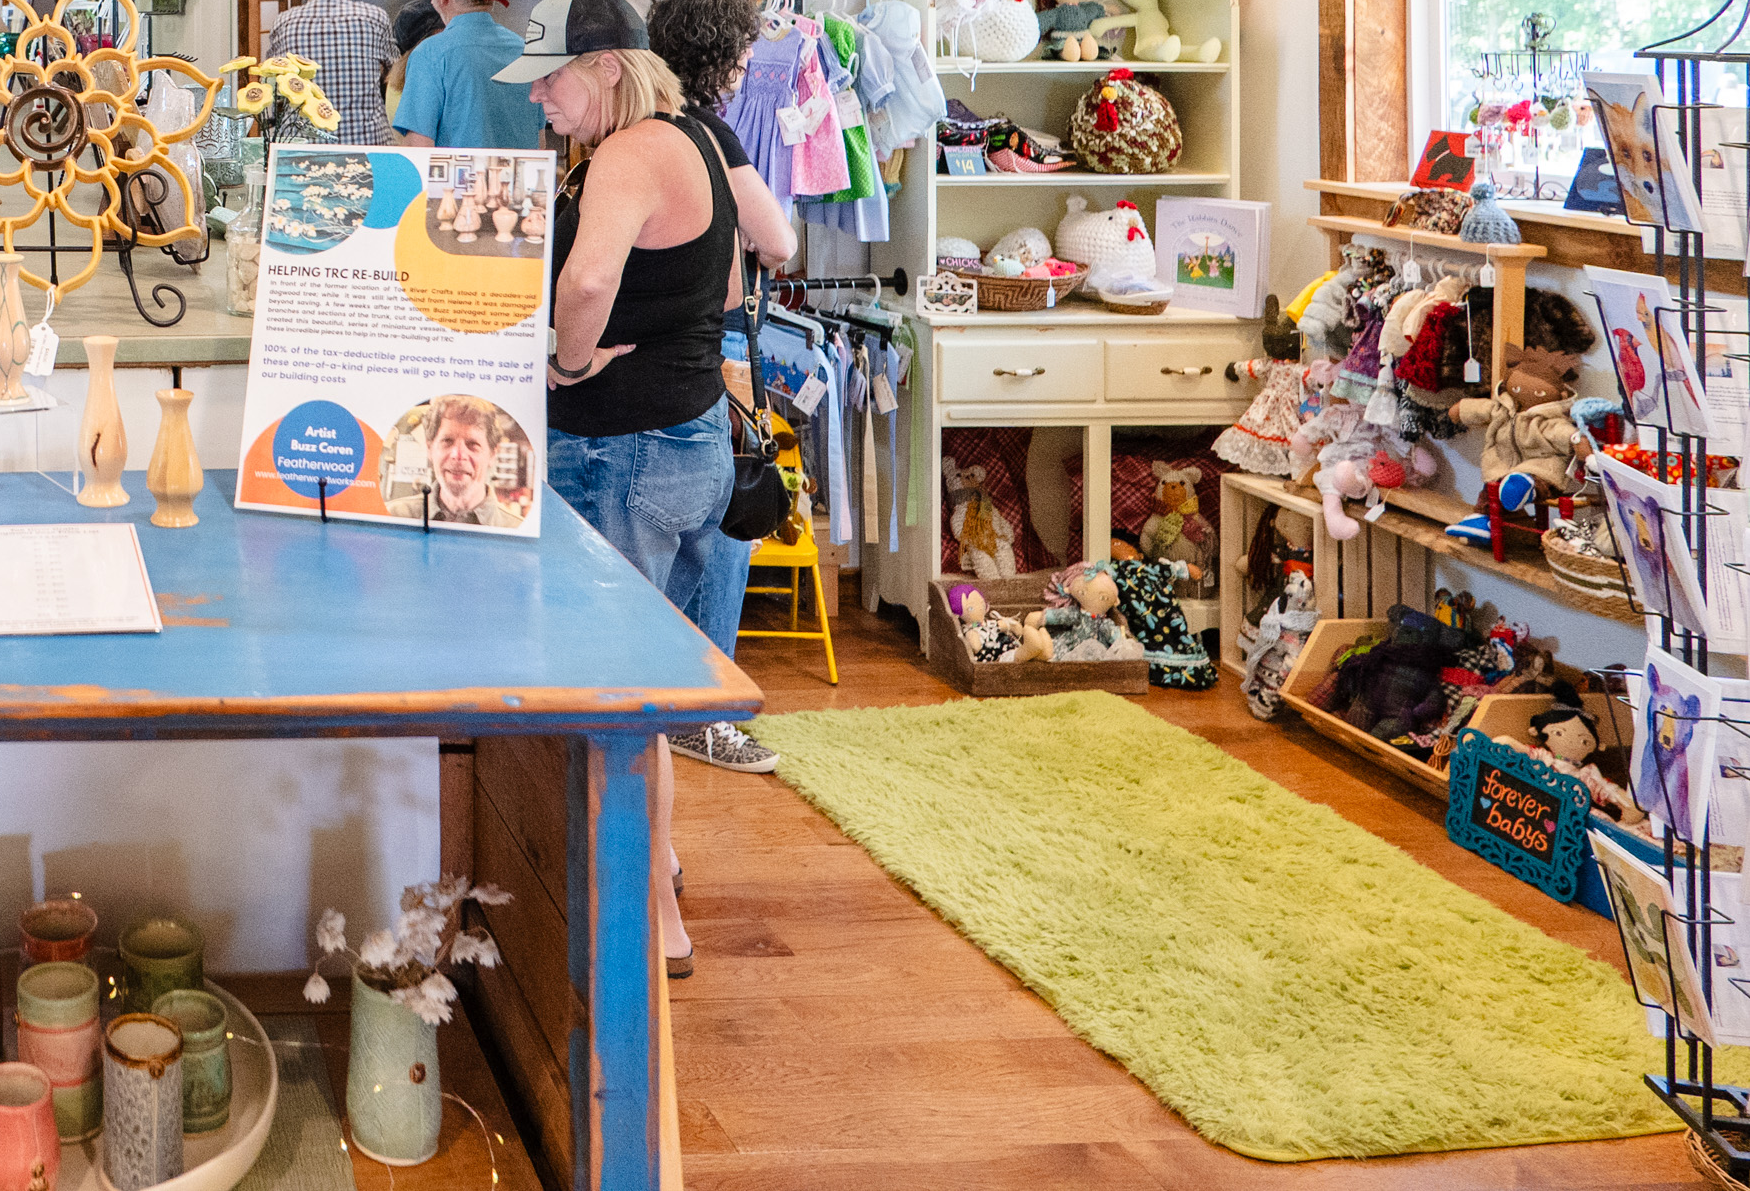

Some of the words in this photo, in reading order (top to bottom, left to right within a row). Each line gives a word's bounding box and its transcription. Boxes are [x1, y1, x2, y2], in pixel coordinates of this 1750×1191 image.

[946, 257, 981, 269] CHICKS
[268, 264, 321, 277] HELPING
[325, 267, 349, 278] TRC
[352, 269, 410, 281] RE-BUILD
[269, 289, 301, 297] dogwood
[500, 301, 536, 310] damaged
[453, 308, 486, 316] salvaged
[381, 322, 416, 330] miniature
[320, 328, 343, 336] pieces
[390, 332, 430, 342] re-building
[264, 344, 288, 353] 100%
[303, 346, 320, 355] the
[322, 348, 396, 360] tax-deductible
[399, 353, 446, 365] proceeds
[449, 356, 474, 365] from
[477, 358, 494, 366] the
[498, 360, 520, 368] sale
[523, 361, 534, 369] of
[263, 357, 289, 366] these
[292, 359, 363, 371] one-of-a-kind
[366, 364, 399, 375] pieces
[402, 366, 420, 374] will
[423, 369, 436, 378] go
[439, 369, 450, 377] to
[453, 370, 476, 380] help
[495, 374, 515, 383] pay
[518, 374, 533, 382] off
[279, 371, 319, 383] building
[320, 374, 346, 383] costs
[304, 425, 337, 439] Artist
[290, 439, 317, 452] Buzz
[318, 441, 354, 455] Coren
[277, 455, 355, 473] Featherwood
[254, 469, 377, 488] www.featherwodworks.com
[1482, 769, 1551, 820] forever
[1486, 802, 1548, 852] babys
